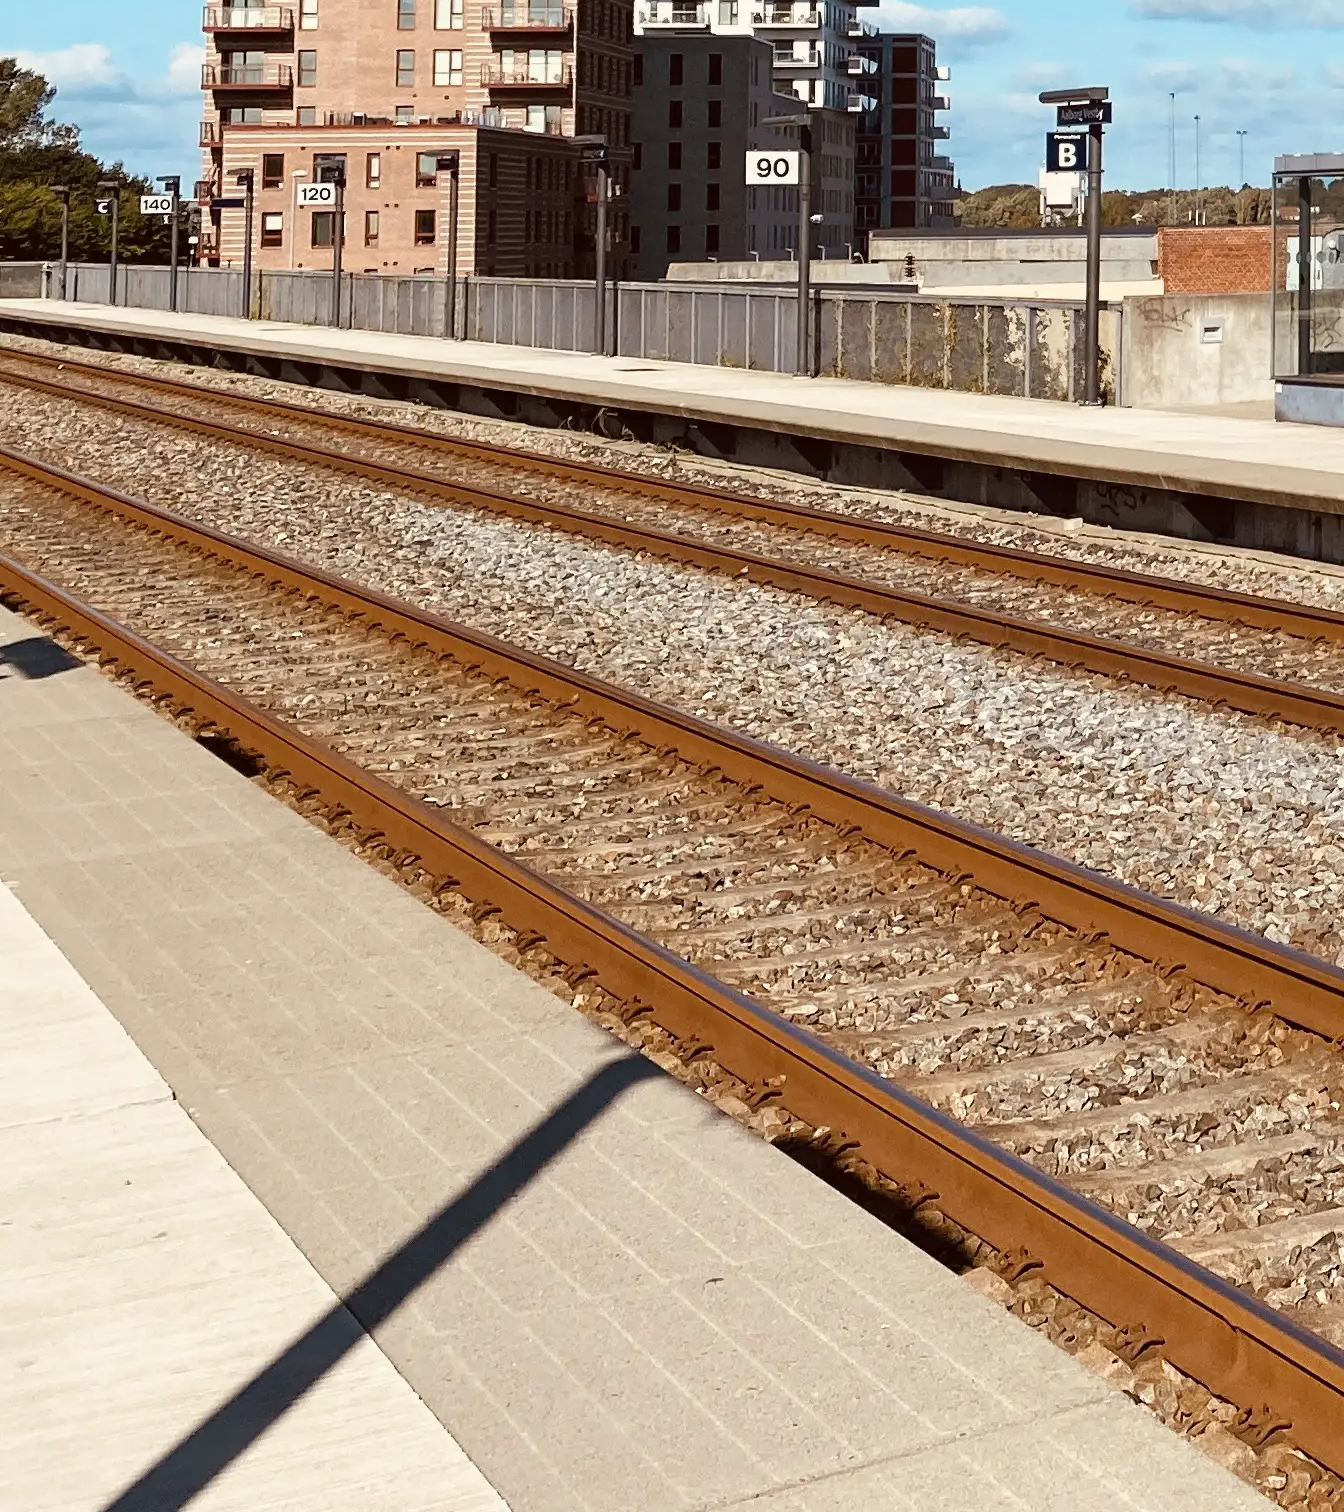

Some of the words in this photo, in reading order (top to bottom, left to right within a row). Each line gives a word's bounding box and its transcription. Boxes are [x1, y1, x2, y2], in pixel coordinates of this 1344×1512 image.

[1058, 142, 1077, 168] B
[756, 157, 790, 178] 90
[300, 187, 331, 201] 120
[98, 202, 108, 214] C
[143, 199, 171, 211] 140
